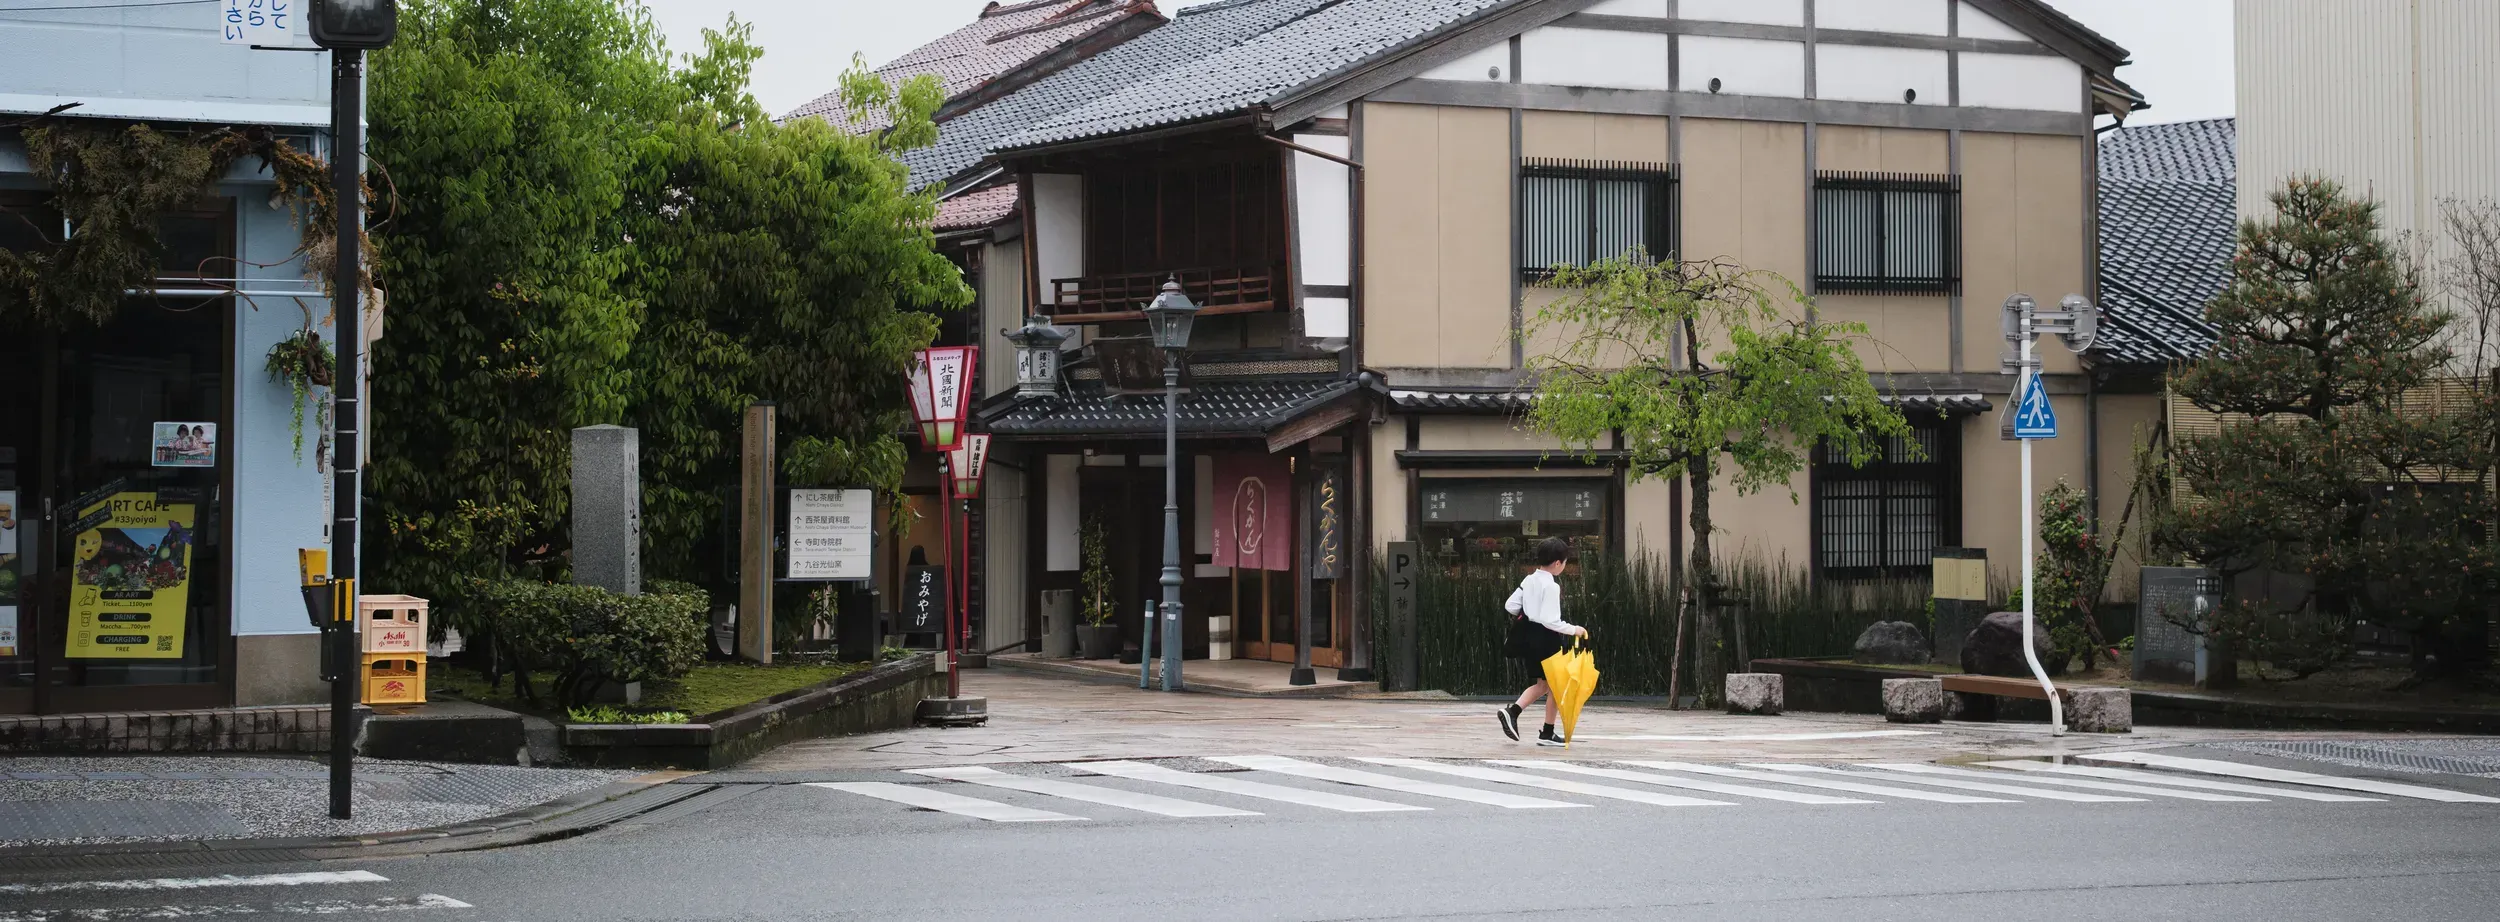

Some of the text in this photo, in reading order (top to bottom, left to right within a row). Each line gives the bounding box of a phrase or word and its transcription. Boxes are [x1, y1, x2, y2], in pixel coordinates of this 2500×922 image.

[939, 363, 955, 409] 北國新聞
[105, 499, 170, 512] ART CAFE
[806, 493, 842, 502] にし茶屋街
[1500, 492, 1515, 518] 落雁
[114, 515, 157, 525] #33yoiyoi
[805, 515, 851, 524] 西茶屋資料館
[1245, 481, 1255, 548] らくがん
[1319, 479, 1338, 573] らくがんや
[805, 537, 842, 546] 寺町寺院群
[1396, 554, 1410, 574] P
[916, 570, 932, 627] おみやげ
[384, 631, 405, 640] Asahi
